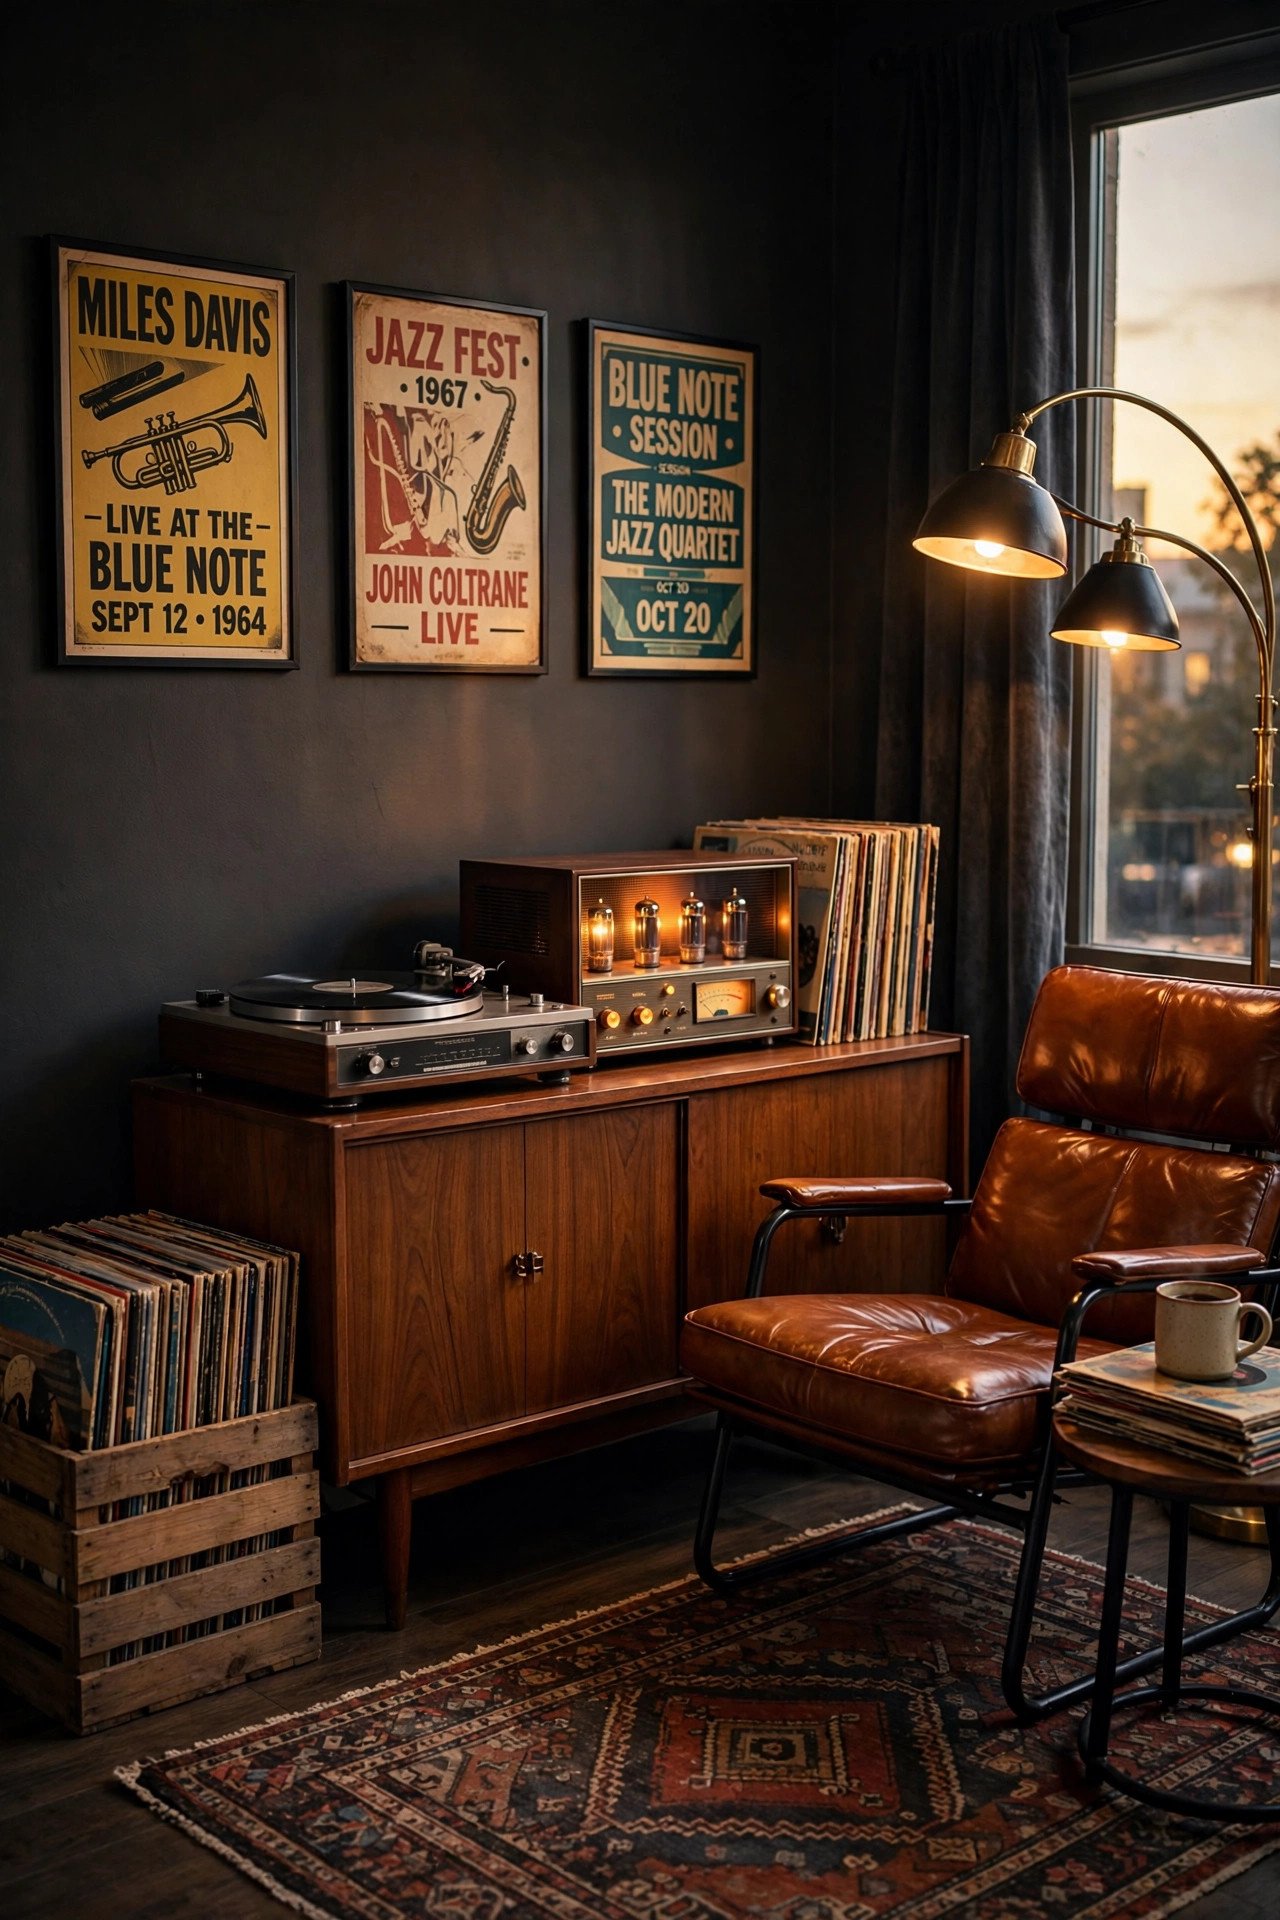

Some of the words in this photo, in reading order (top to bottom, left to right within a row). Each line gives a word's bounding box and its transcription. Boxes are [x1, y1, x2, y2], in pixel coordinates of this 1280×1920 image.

[77, 275, 175, 346] MILES
[184, 290, 271, 357] DAVIS
[365, 315, 444, 371] JAZZ
[453, 326, 521, 380] FEST
[415, 375, 468, 408] 1967
[608, 357, 671, 414] BLUE
[677, 367, 739, 422] NOTE
[629, 414, 718, 462] SESSION
[106, 503, 161, 536] LIVE
[169, 509, 200, 538] AT
[207, 510, 253, 541] THE
[611, 479, 649, 517] THE
[655, 482, 735, 523] MODERN
[606, 519, 654, 557] JAZZ
[658, 523, 740, 564] QUARTET
[89, 540, 173, 594] BLUE
[186, 546, 266, 597] NOTE
[365, 563, 423, 604] JOHN
[429, 566, 529, 608] COLTRANE
[91, 599, 154, 633] SEPT
[162, 603, 188, 634] 12
[212, 604, 267, 636] 1964
[421, 611, 479, 645] LIVE
[636, 599, 679, 633] OCT
[683, 601, 711, 635] 20
